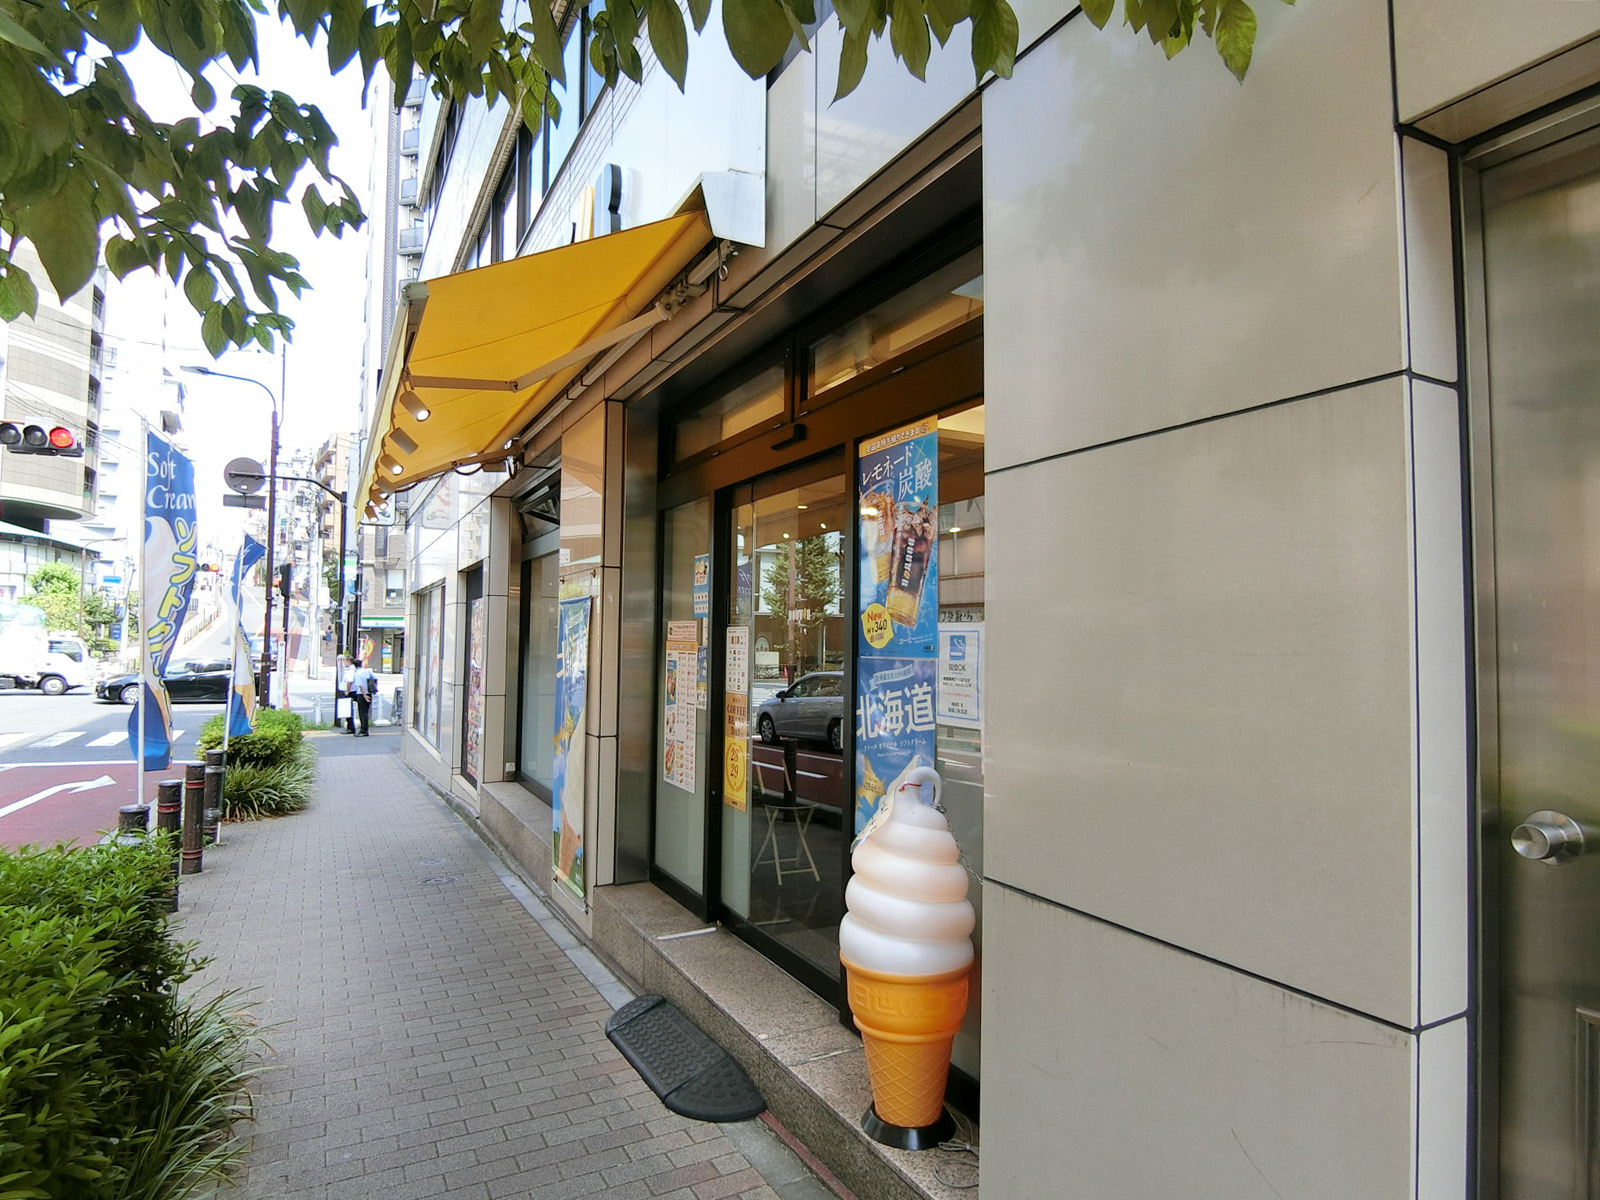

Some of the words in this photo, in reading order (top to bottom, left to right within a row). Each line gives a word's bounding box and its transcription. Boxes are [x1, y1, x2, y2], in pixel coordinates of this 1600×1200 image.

[147, 451, 177, 491] Soft
[897, 458, 933, 501] 炭酸
[726, 704, 747, 717] COFFEE
[855, 681, 936, 742] 北海道
